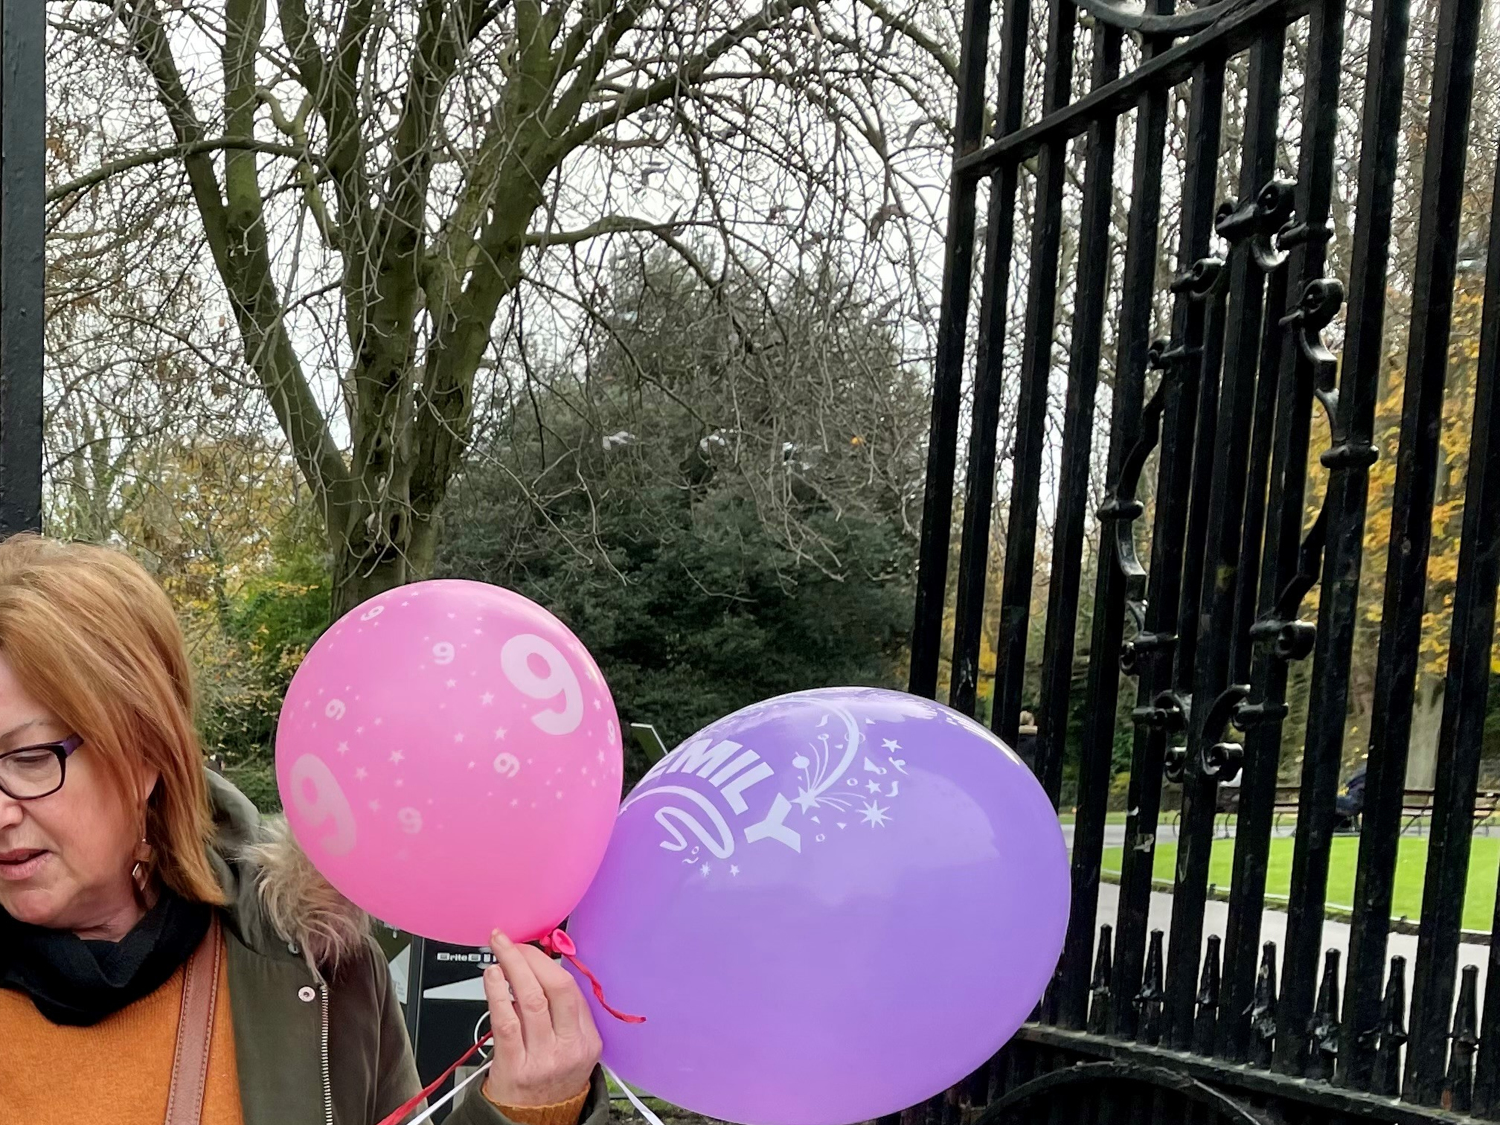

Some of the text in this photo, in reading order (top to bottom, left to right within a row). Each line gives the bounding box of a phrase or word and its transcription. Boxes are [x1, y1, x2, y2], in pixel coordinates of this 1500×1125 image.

[432, 641, 456, 665] 9
[501, 633, 584, 736] 9
[325, 698, 347, 720] 9
[493, 752, 520, 778] 9
[290, 753, 357, 857] 9
[398, 806, 422, 834] 9
